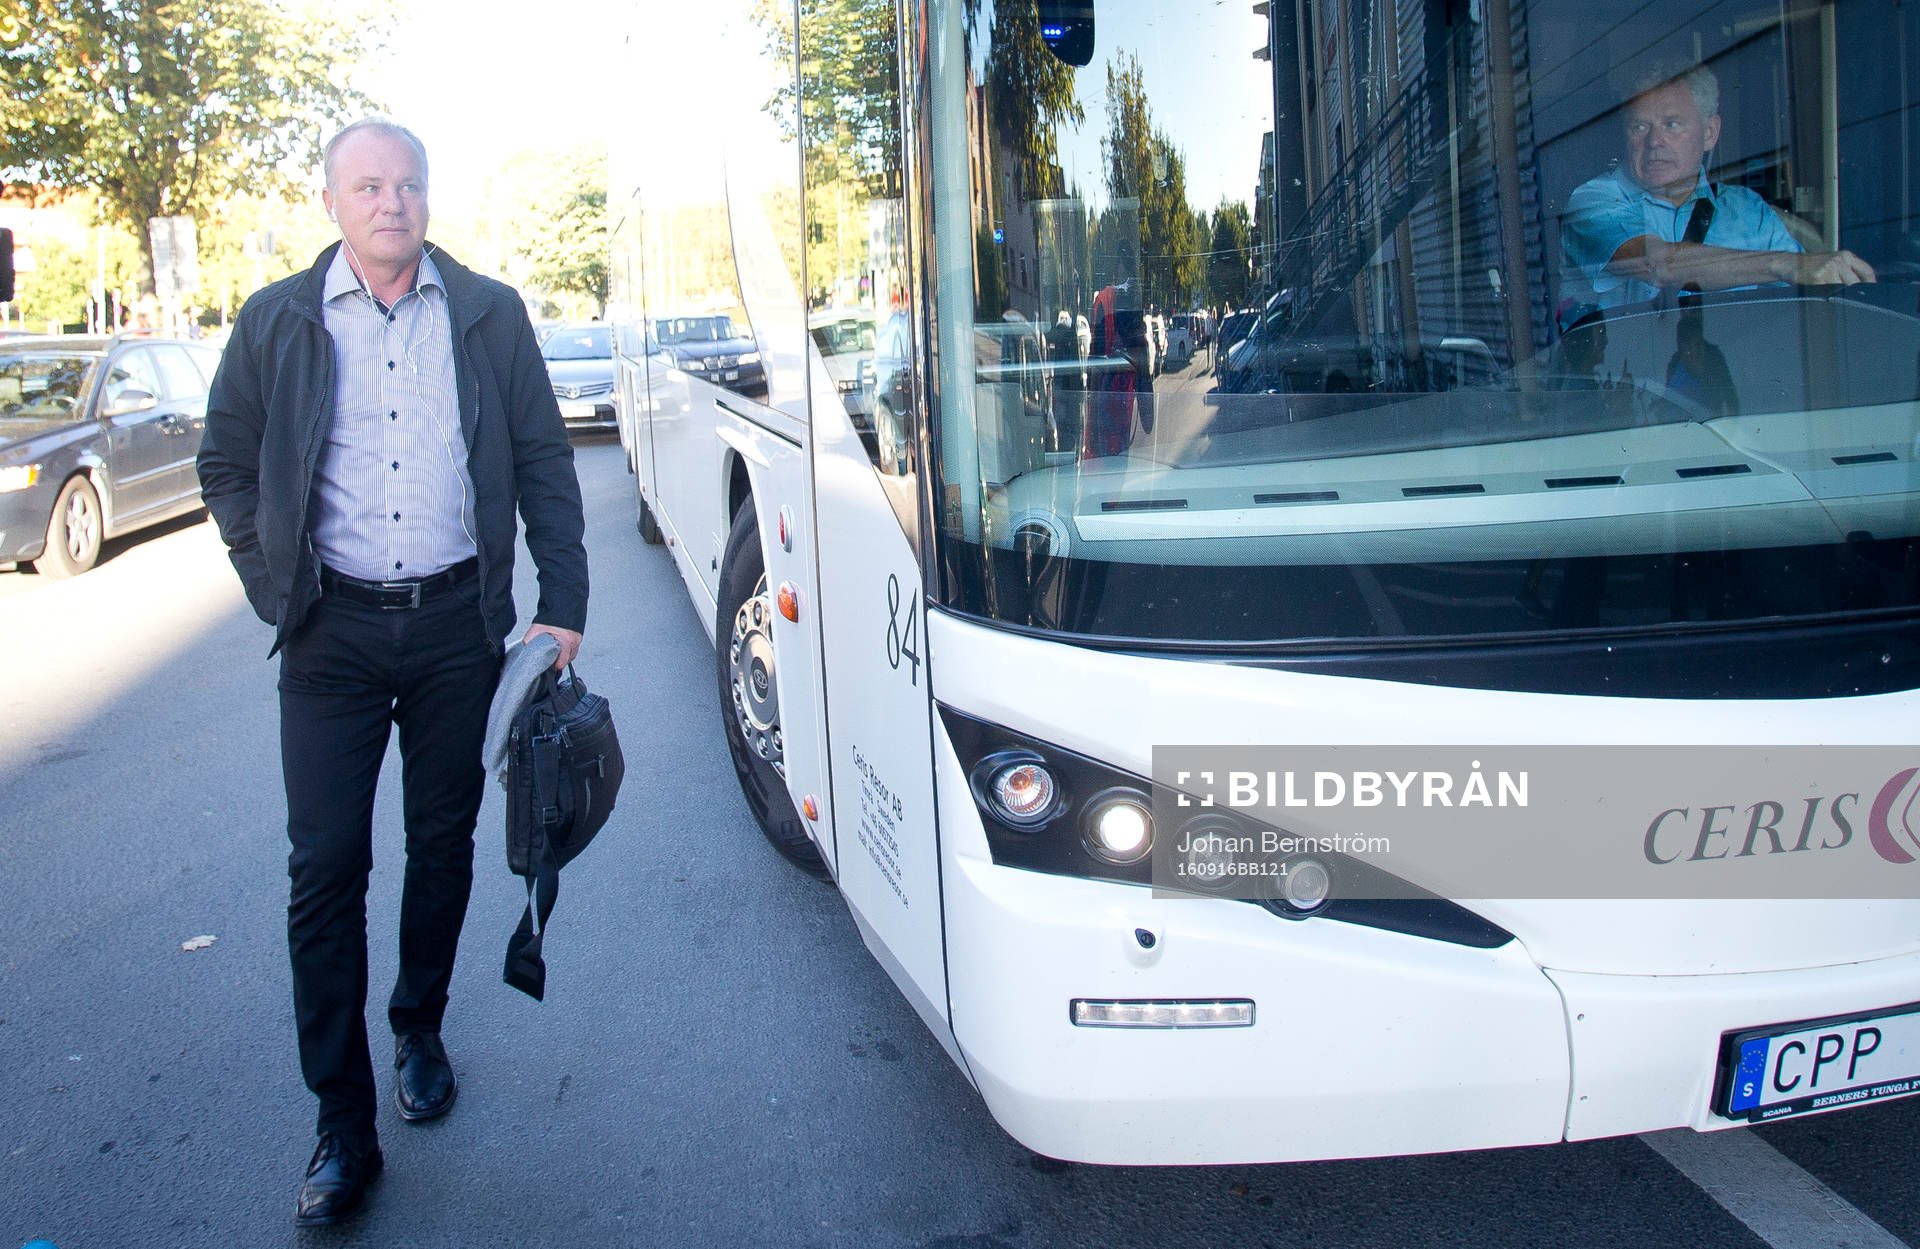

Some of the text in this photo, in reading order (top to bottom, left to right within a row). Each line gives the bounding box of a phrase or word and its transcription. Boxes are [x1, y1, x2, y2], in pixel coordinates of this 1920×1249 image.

[887, 573, 920, 687] 84
[853, 744, 903, 822] Ceris Resor AB
[1643, 792, 1859, 865] CERIS
[1742, 1082, 1754, 1097] S
[1773, 1026, 1882, 1093] CPP
[1762, 1106, 1792, 1118] SCANIA
[1812, 1079, 1920, 1108] BERNERS TUNGA F
